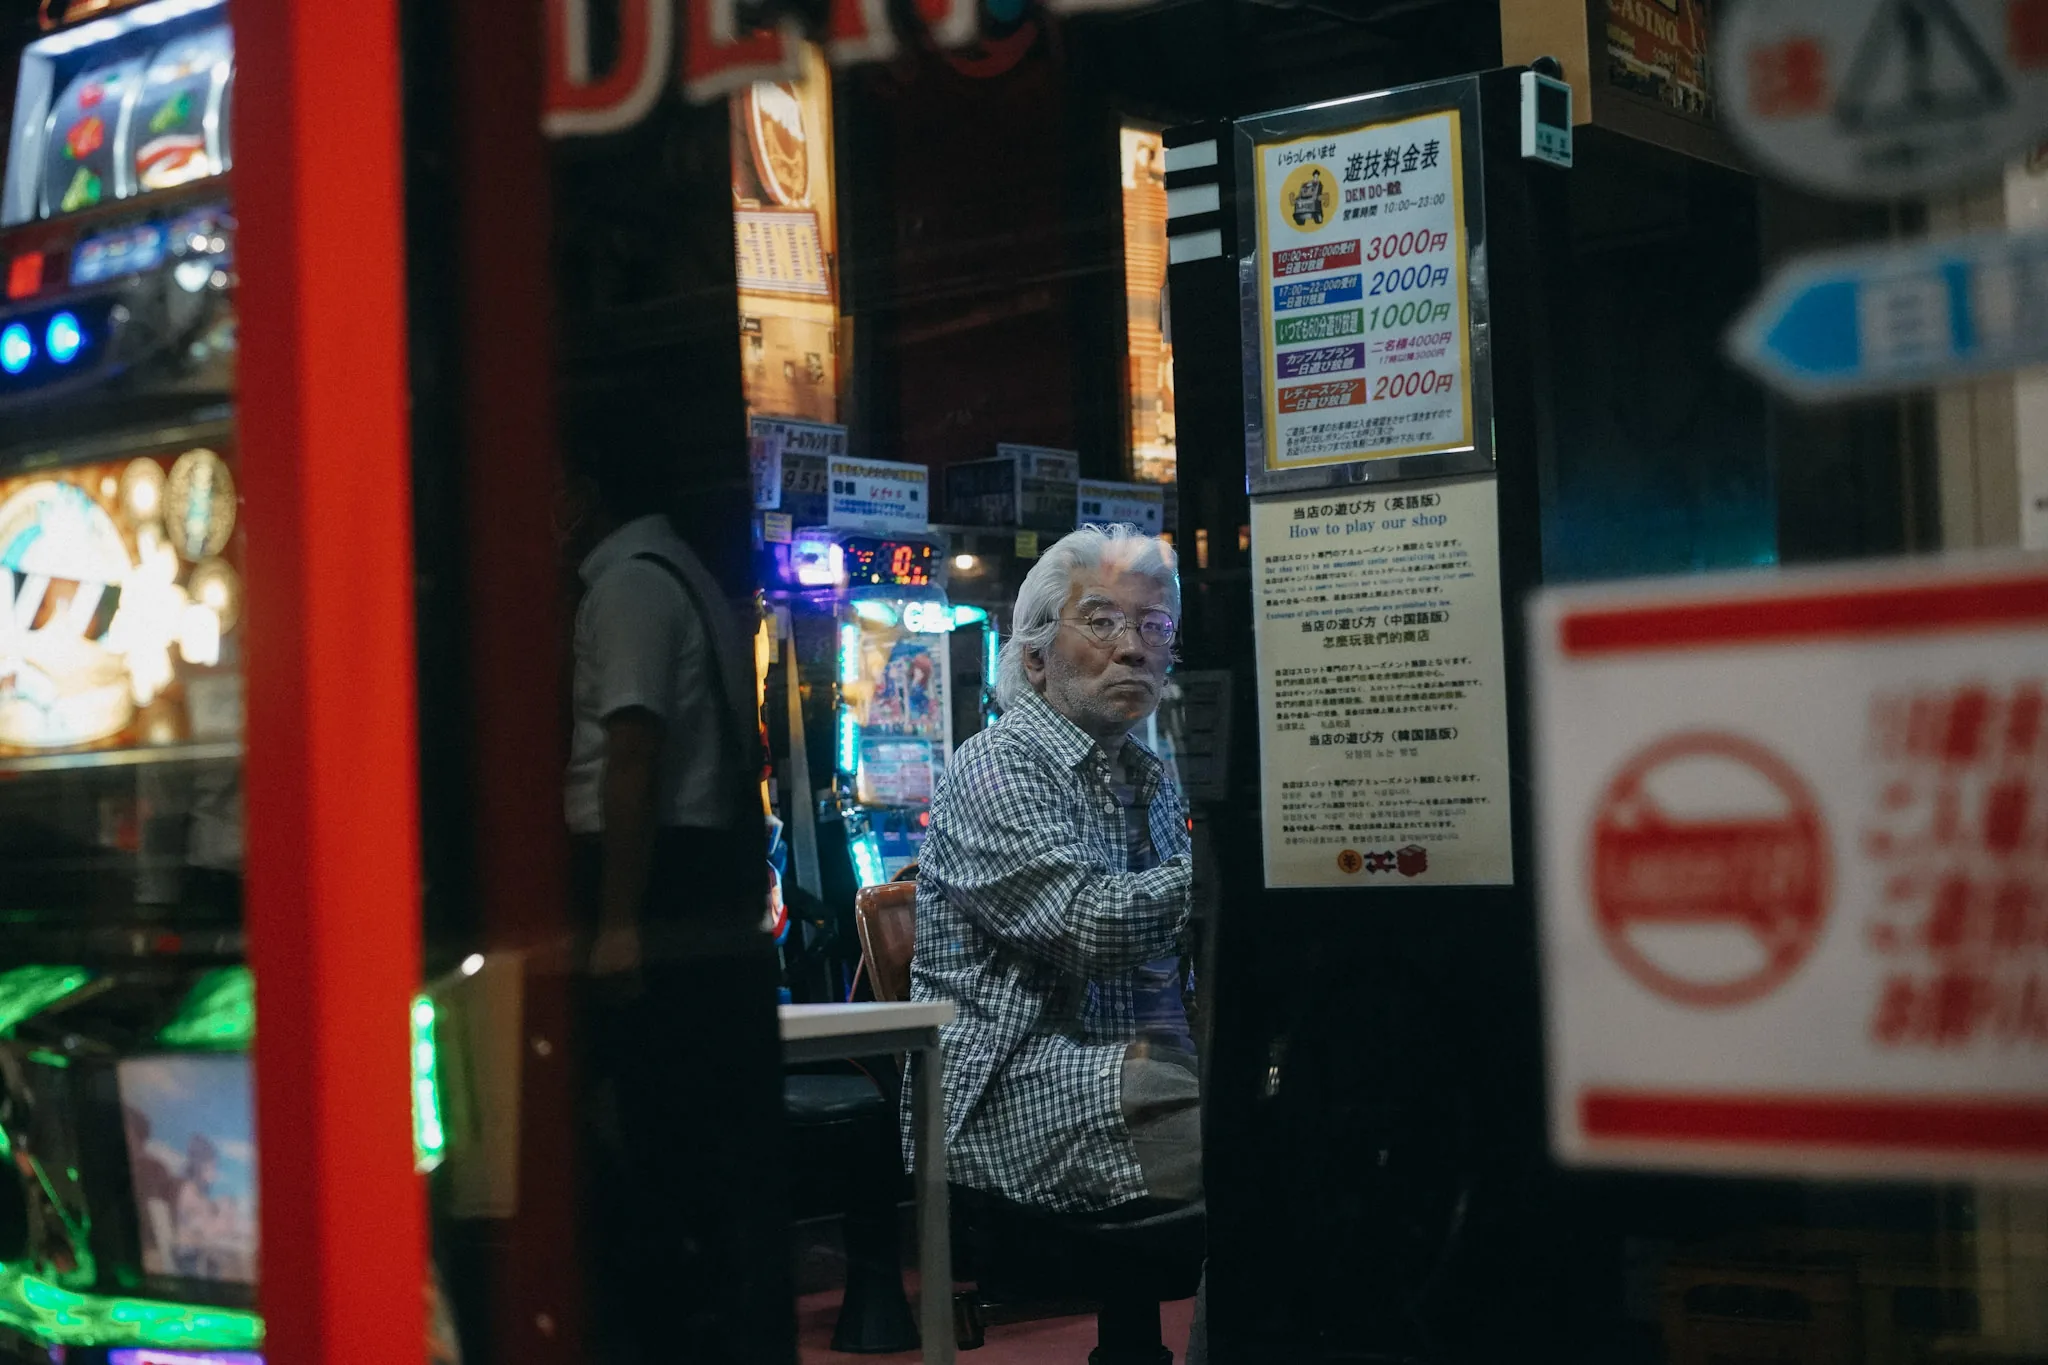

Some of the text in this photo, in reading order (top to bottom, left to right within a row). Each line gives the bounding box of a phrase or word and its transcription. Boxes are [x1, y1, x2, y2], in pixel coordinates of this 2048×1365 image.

[1277, 143, 1337, 167] いらっしゃいませ
[1342, 139, 1440, 184] 遊技料金表
[1345, 186, 1367, 203] DEN
[1342, 206, 1378, 222] 営業時間
[1367, 229, 1449, 262] 3000円
[1369, 264, 1449, 296] 2000円
[1370, 299, 1451, 331] 1000円
[1371, 331, 1452, 354] 二名様4000円
[1286, 346, 1355, 366] カップルプラン
[1287, 358, 1355, 377] 一日遊び放題
[1283, 381, 1359, 401] レディースプラン
[1373, 370, 1453, 401] 2000円
[1285, 393, 1351, 411] 一日遊び放題
[1293, 492, 1441, 520] 当店の遊び方（英語版）
[1289, 513, 1447, 539] How to play our shop
[1301, 610, 1450, 633] 当店の遊び方（中国語版）
